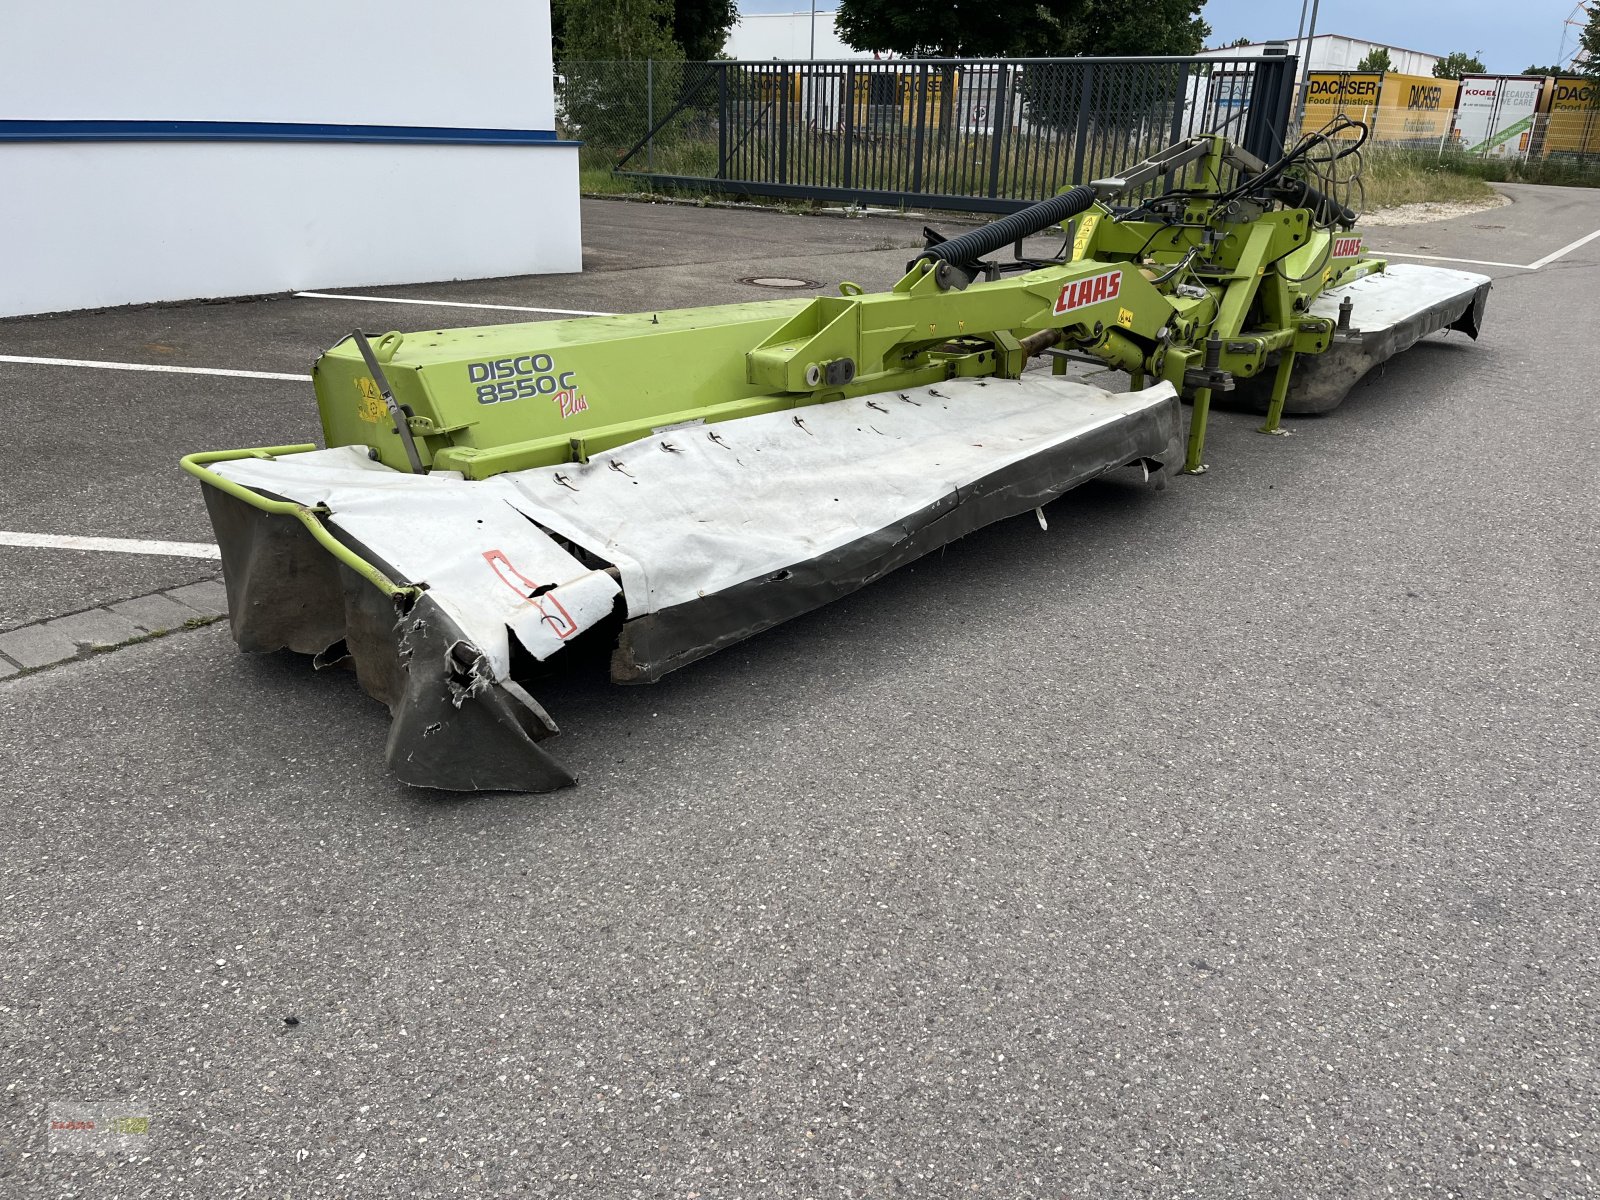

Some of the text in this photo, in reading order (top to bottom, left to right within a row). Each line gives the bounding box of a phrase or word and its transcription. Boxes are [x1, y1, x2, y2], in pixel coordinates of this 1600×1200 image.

[1310, 81, 1376, 95] DACHSER
[1408, 85, 1441, 110] DACHSER
[1333, 97, 1373, 106] Logistics
[1513, 98, 1533, 106] CARE
[1333, 239, 1361, 257] CLAAS
[1055, 272, 1121, 312] CLAAS
[468, 354, 554, 383] DISCO
[476, 371, 578, 405] 8550 C
[552, 389, 588, 419] Plus
